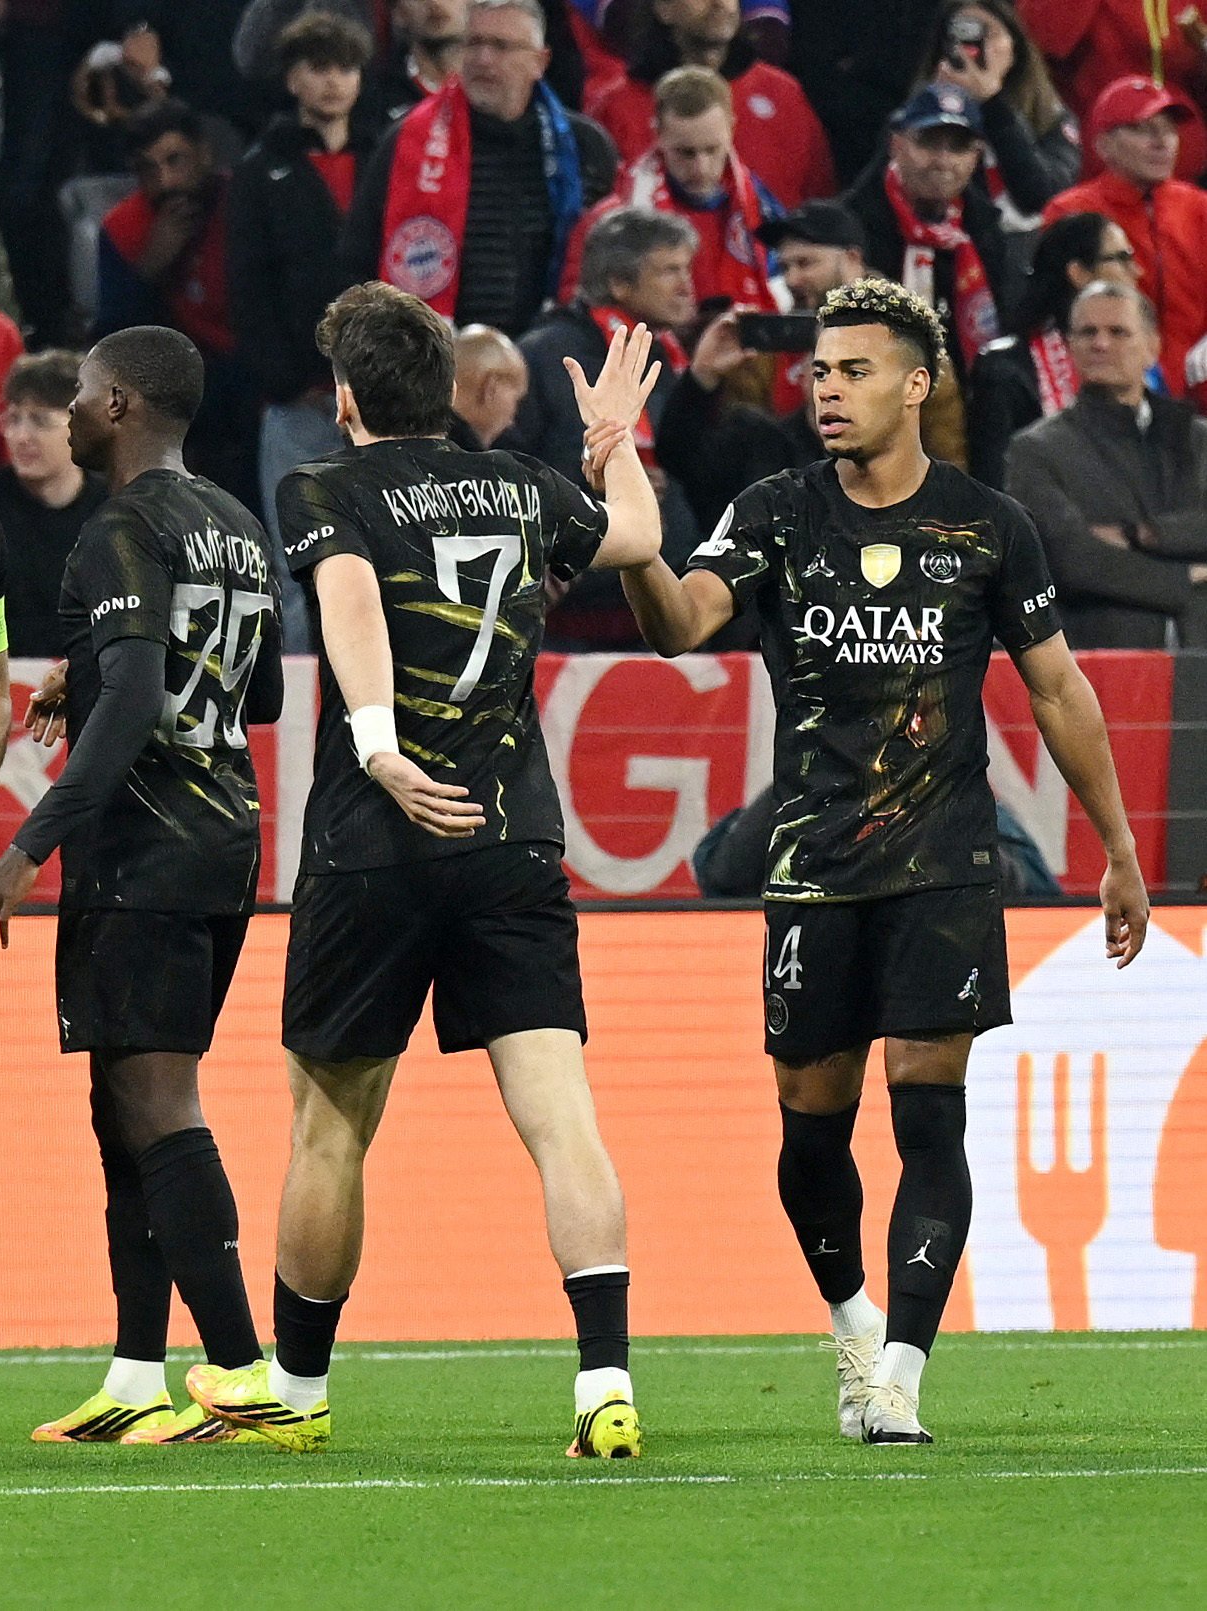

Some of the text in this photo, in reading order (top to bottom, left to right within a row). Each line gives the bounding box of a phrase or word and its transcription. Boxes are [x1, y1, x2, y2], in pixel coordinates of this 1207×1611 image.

[382, 479, 542, 527] KVARATSKHELIA
[432, 535, 521, 702] 7
[803, 605, 944, 647] QATAR
[835, 643, 944, 665] AIRWAYS
